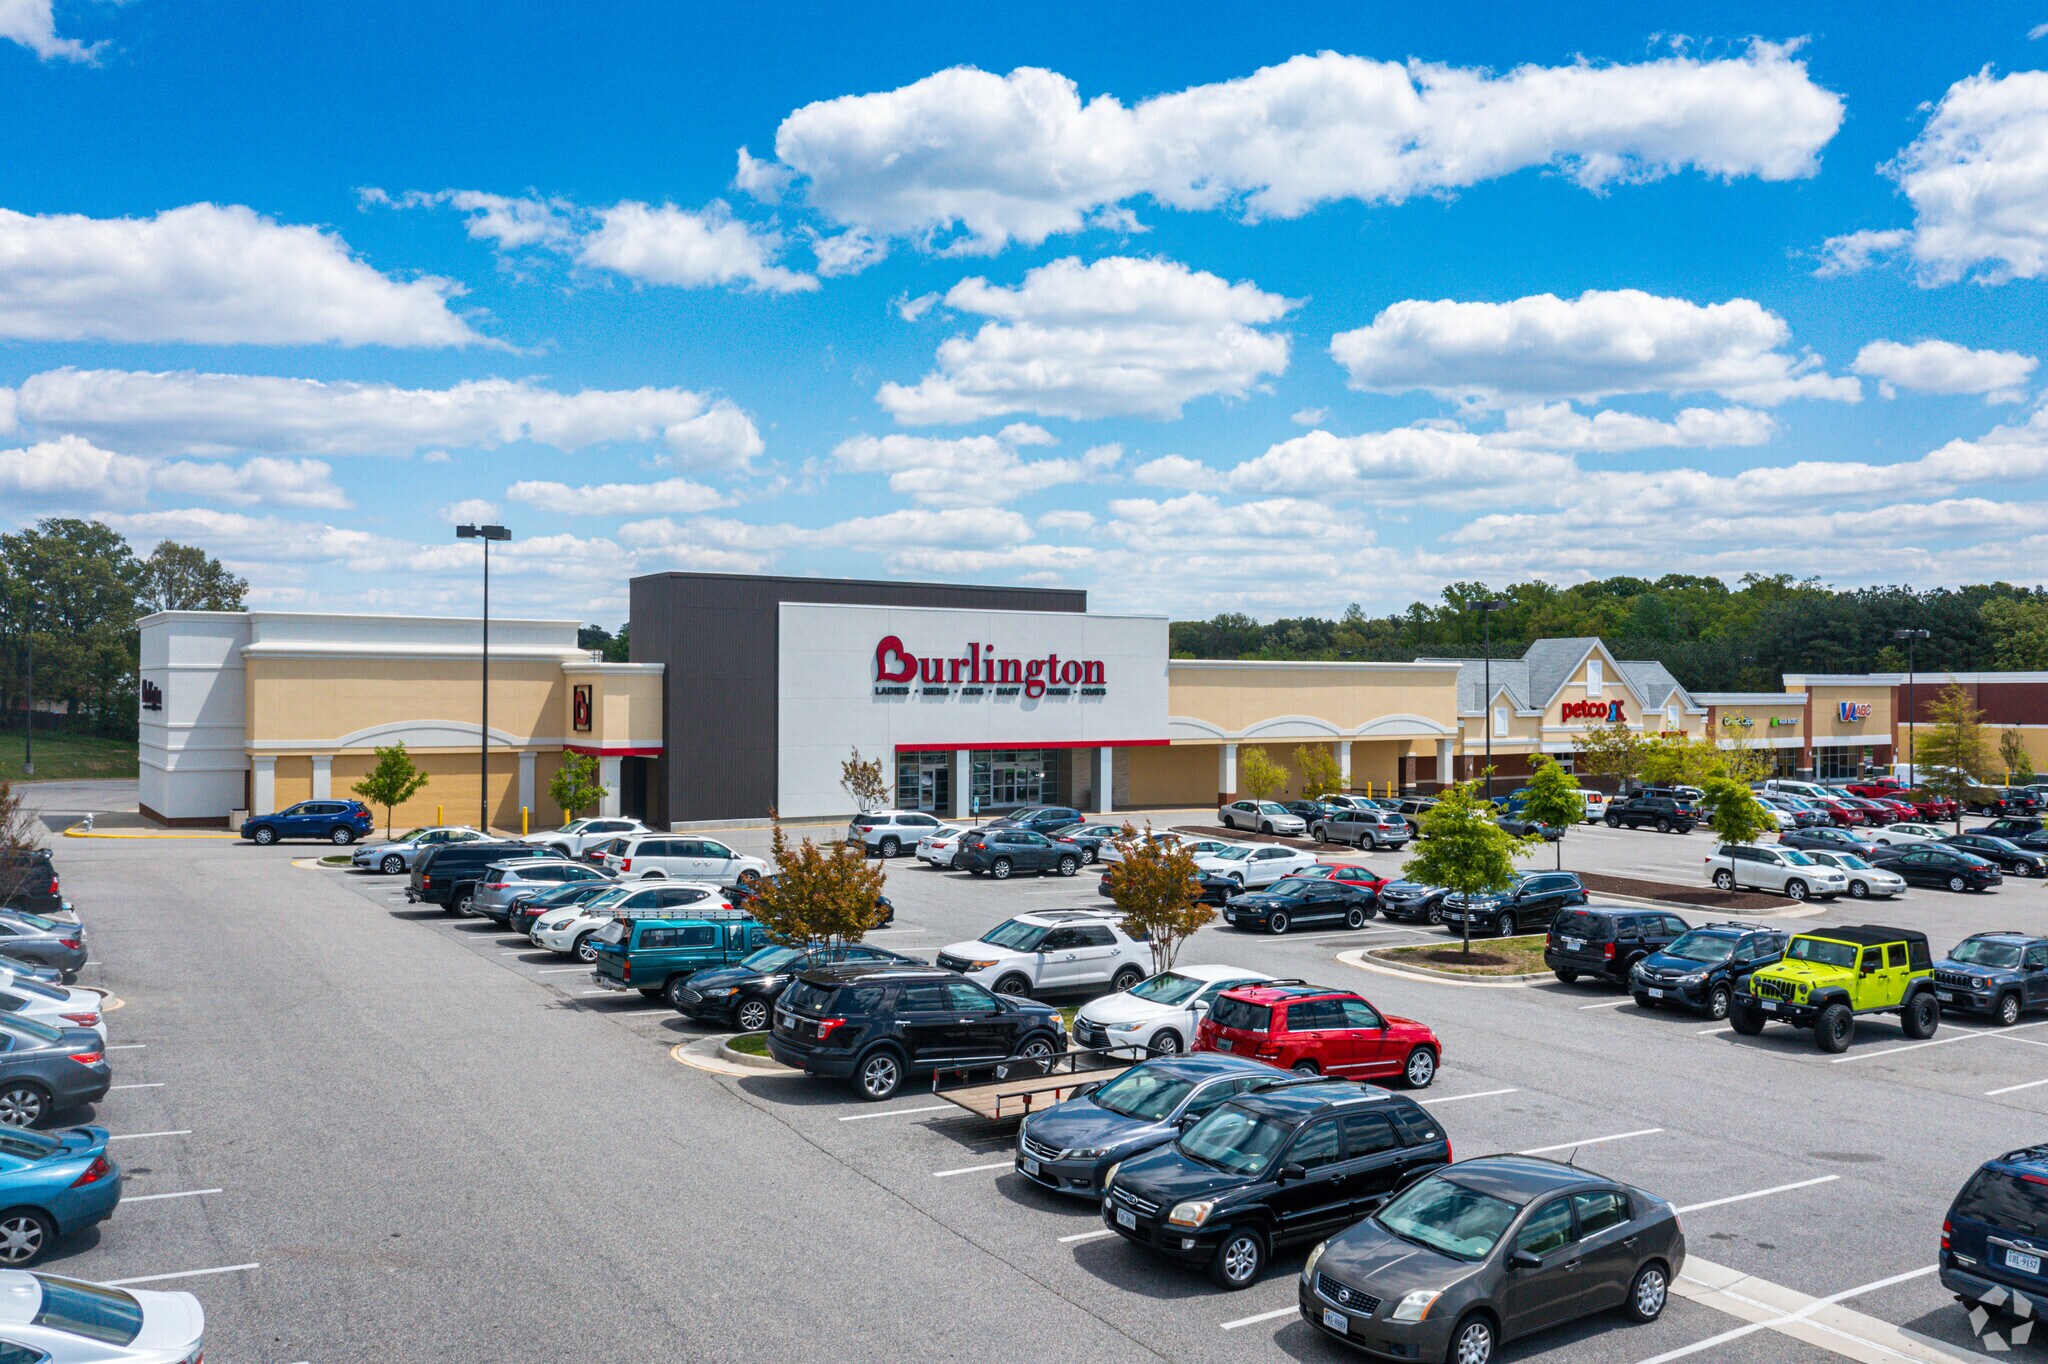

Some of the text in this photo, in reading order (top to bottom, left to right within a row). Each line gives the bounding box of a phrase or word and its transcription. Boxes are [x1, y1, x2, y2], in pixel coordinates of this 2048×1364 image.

[875, 635, 1107, 698] Burlington
[875, 687, 1107, 696] LADIES MENS KIDS BABY HOME COATS
[1562, 700, 1607, 723] petco
[1856, 703, 1872, 717] ABC
